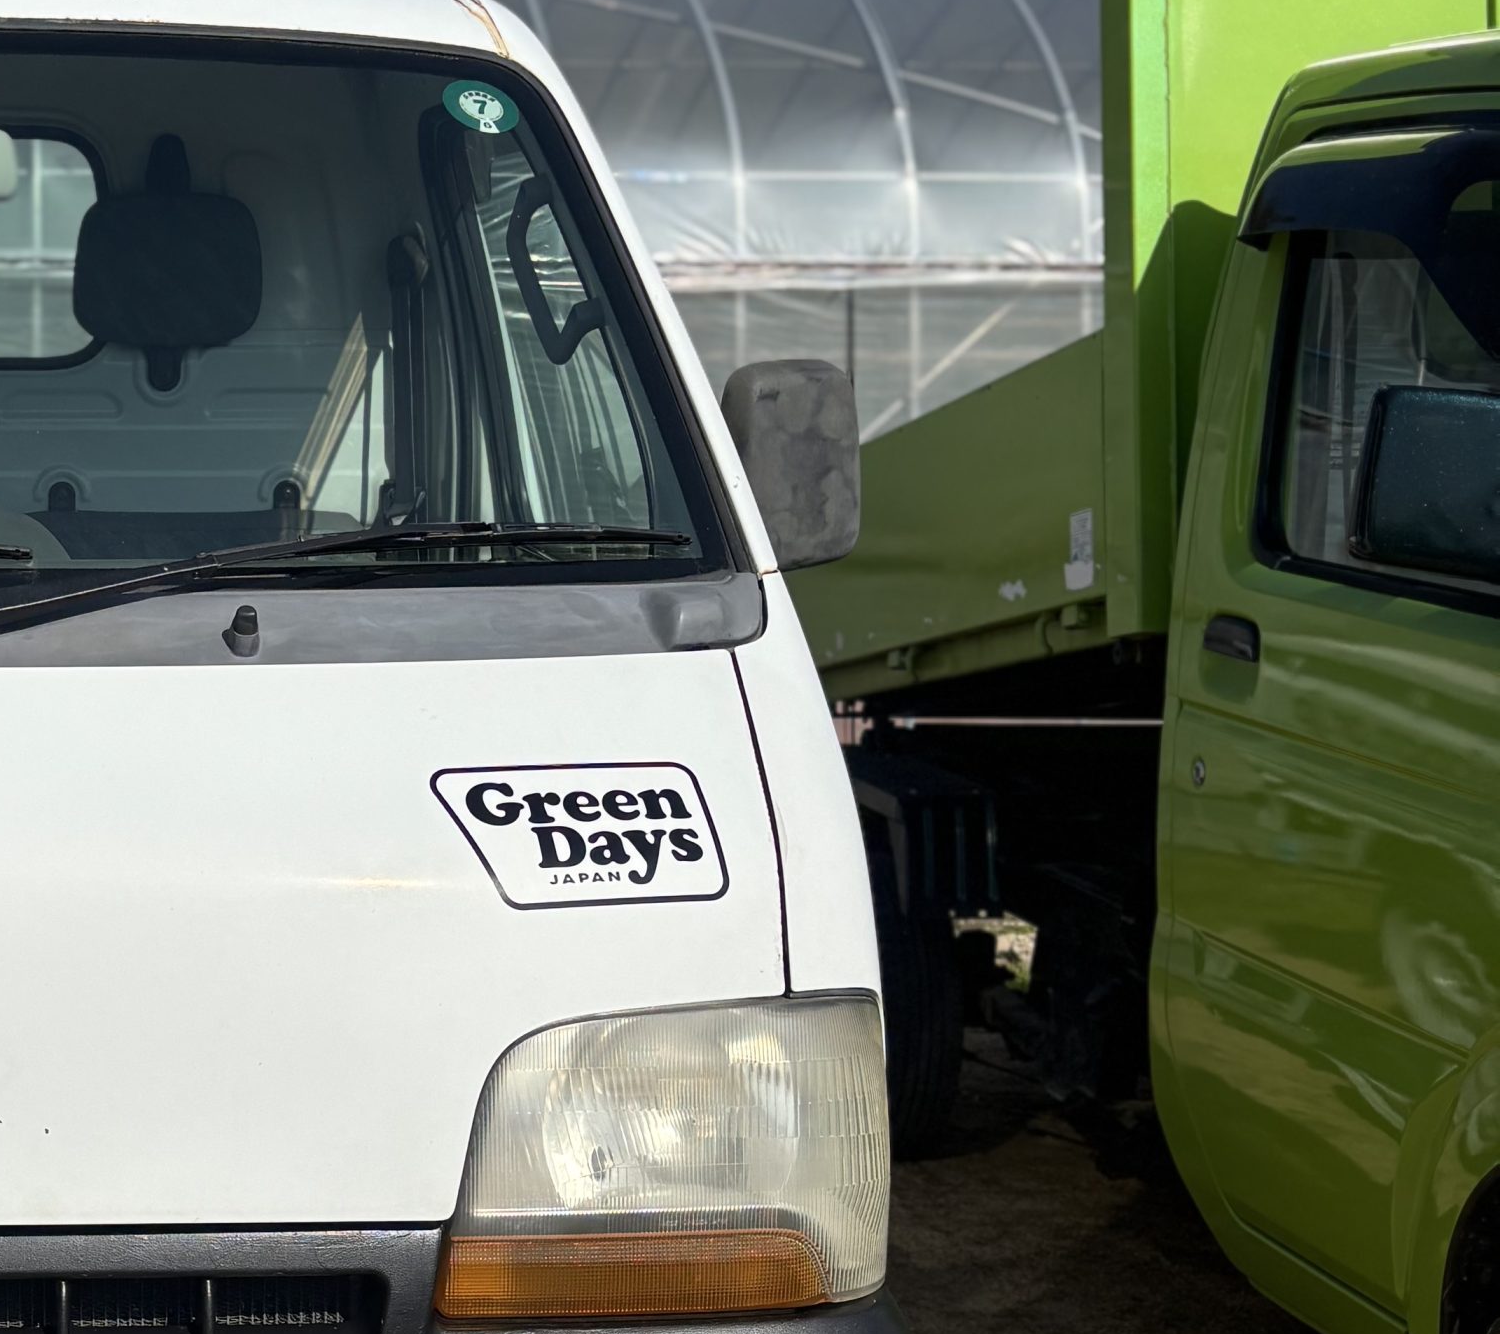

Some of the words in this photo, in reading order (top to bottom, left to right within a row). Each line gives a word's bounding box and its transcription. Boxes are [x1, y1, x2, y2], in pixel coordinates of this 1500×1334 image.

[472, 98, 487, 115] 7
[465, 782, 692, 826] Green
[531, 825, 704, 885] Days
[549, 871, 621, 885] JAPAN
